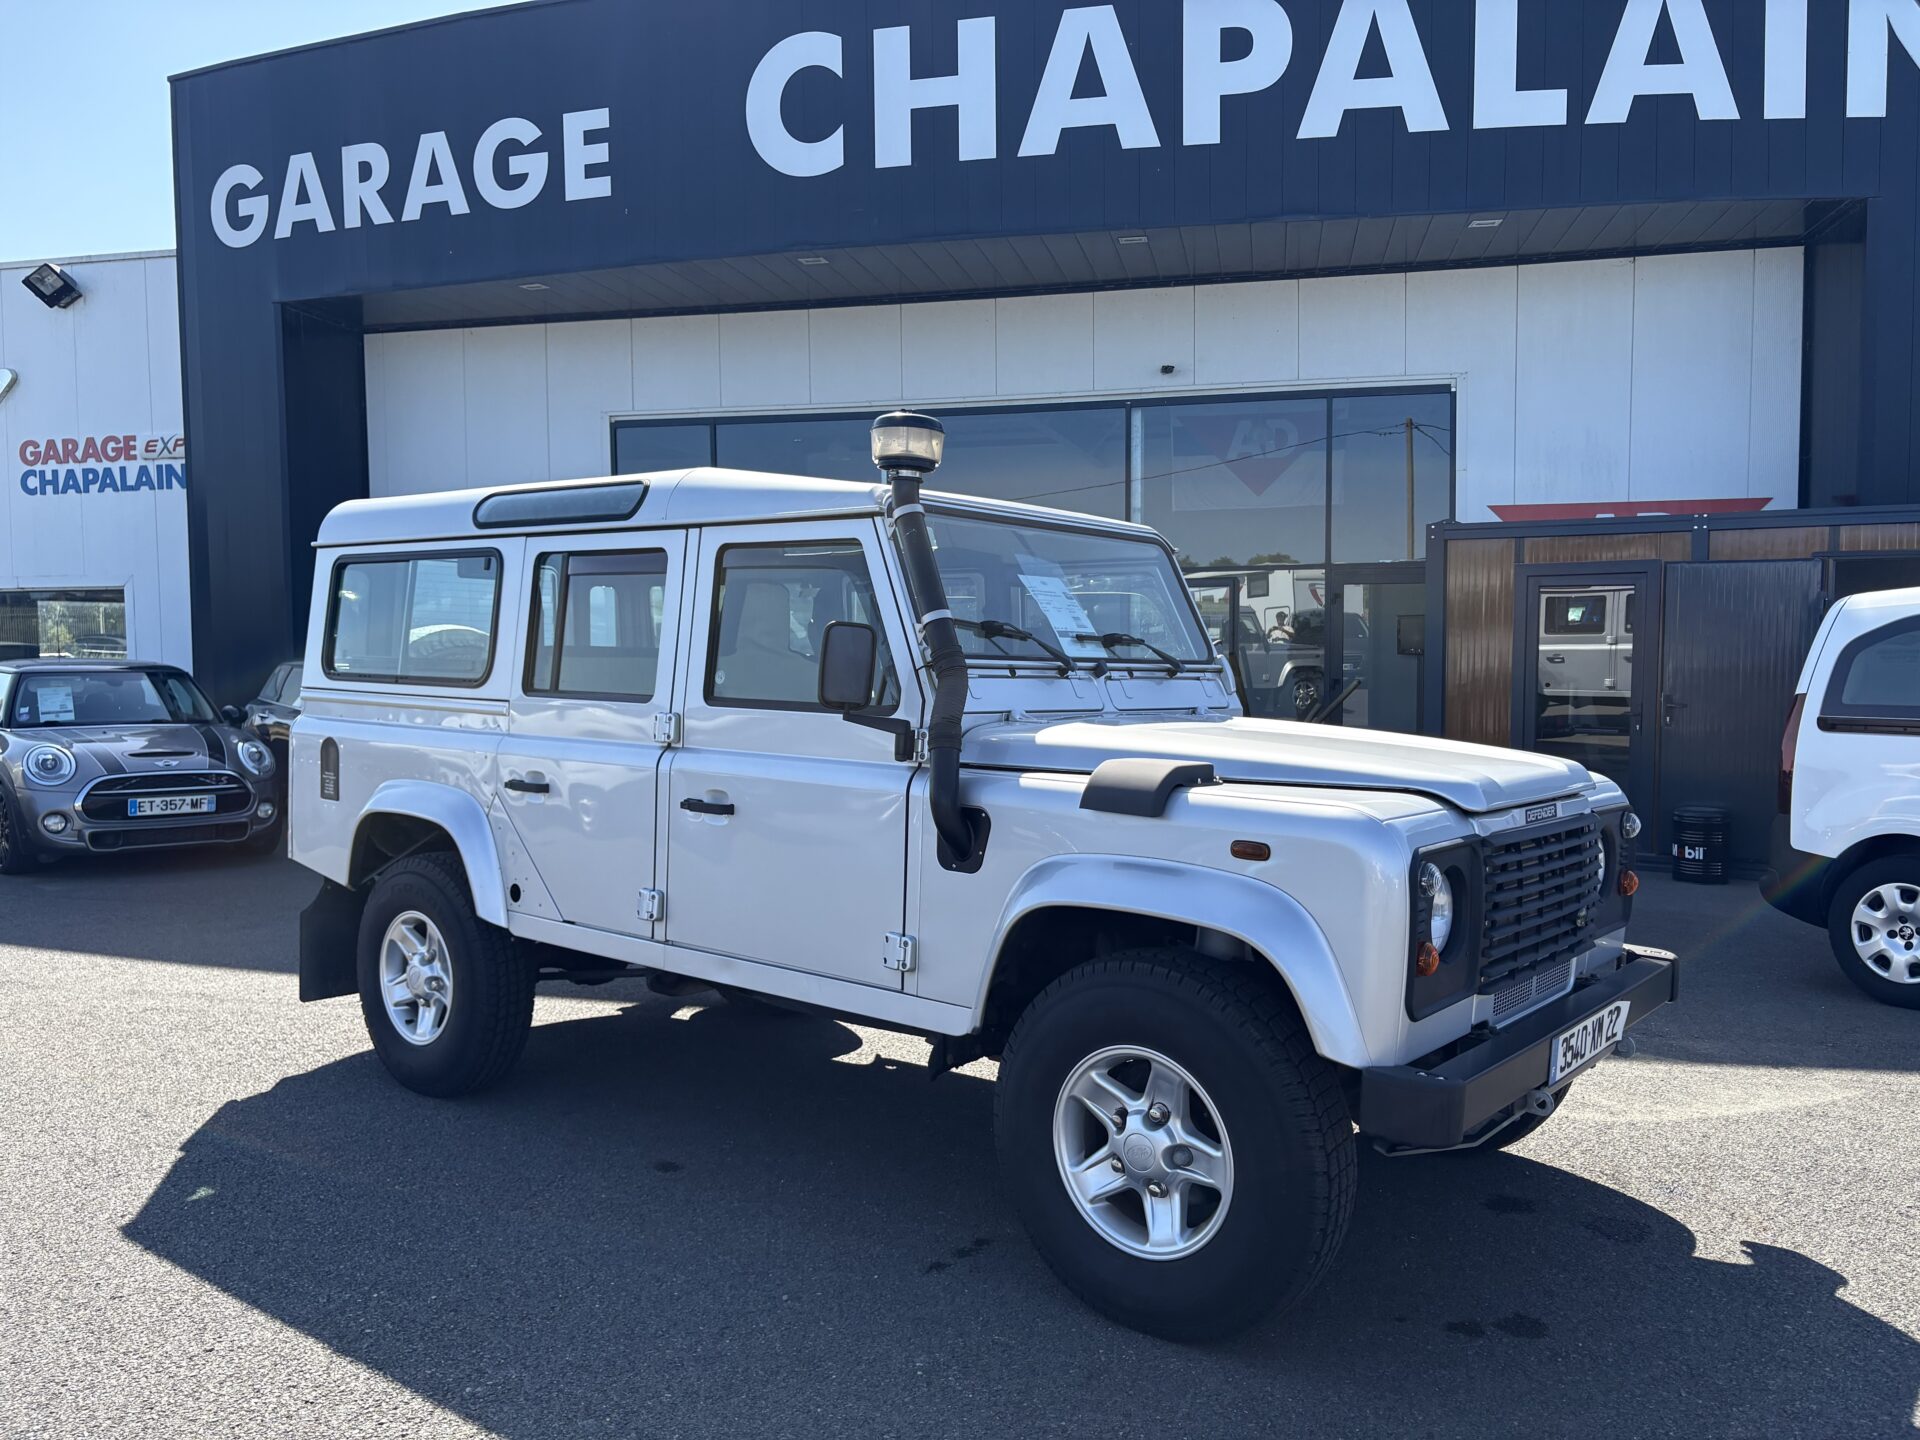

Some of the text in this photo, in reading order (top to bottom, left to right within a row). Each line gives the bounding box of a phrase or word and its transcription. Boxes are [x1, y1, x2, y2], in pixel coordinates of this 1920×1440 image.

[210, 107, 612, 249] GARAGE
[19, 435, 138, 467] GARAGE
[20, 463, 188, 496] CHAPALAIN
[1526, 805, 1556, 822] DEFENDER
[1605, 1005, 1621, 1043] 22
